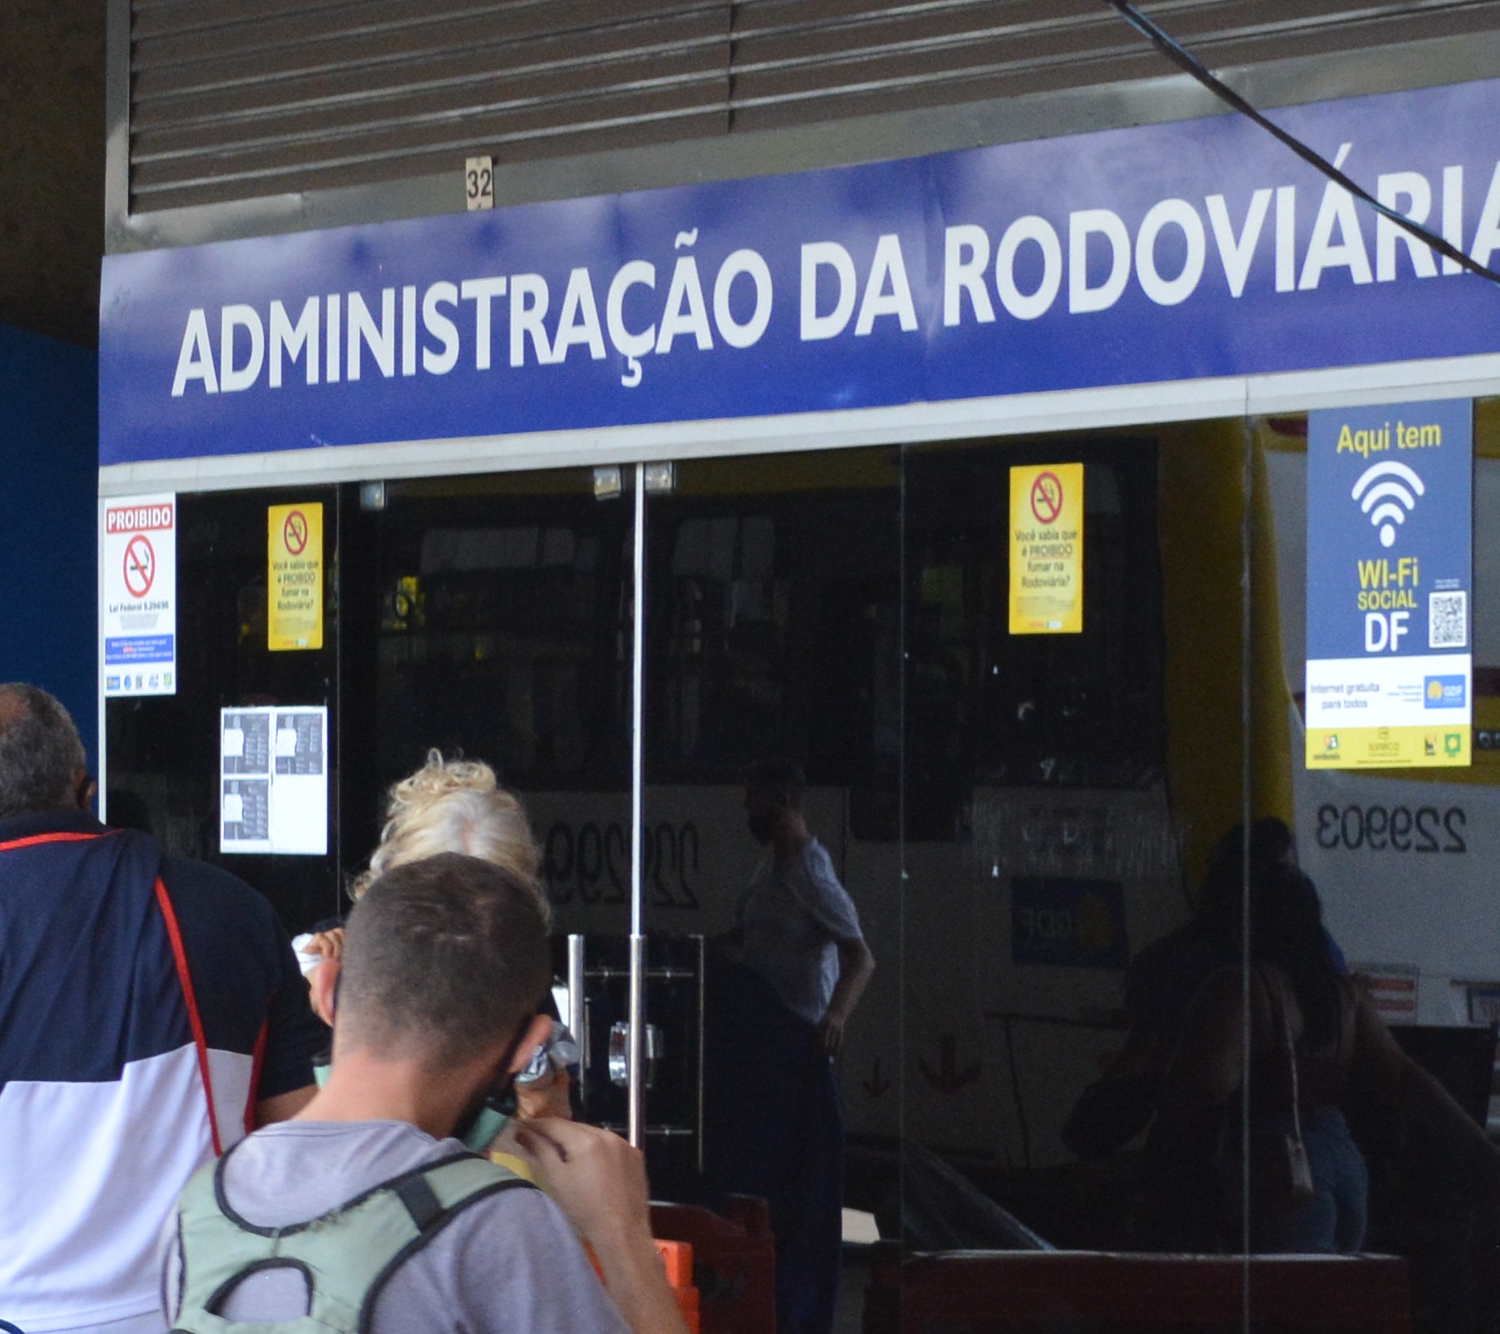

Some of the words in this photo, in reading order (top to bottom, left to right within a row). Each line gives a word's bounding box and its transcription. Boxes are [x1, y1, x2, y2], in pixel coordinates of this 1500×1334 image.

[467, 169, 491, 199] 32
[171, 227, 773, 396] ADMINISTRAÇÃO
[800, 234, 918, 341] DA
[1337, 422, 1390, 459] Aqui
[1396, 420, 1441, 451] tem
[108, 505, 171, 531] PROIBIDO
[1015, 530, 1036, 541] Você
[1038, 531, 1059, 540] sabia
[1061, 531, 1077, 543] que
[1029, 545, 1073, 557] PROIBIDO
[1028, 561, 1051, 572] fumar
[1053, 562, 1064, 572] na
[1357, 589, 1418, 611] SOCIAL
[1364, 611, 1410, 652] DF
[1311, 683, 1344, 694] Internet
[1346, 682, 1380, 695] gratuita
[1321, 700, 1341, 710] para
[1344, 699, 1368, 709] todos
